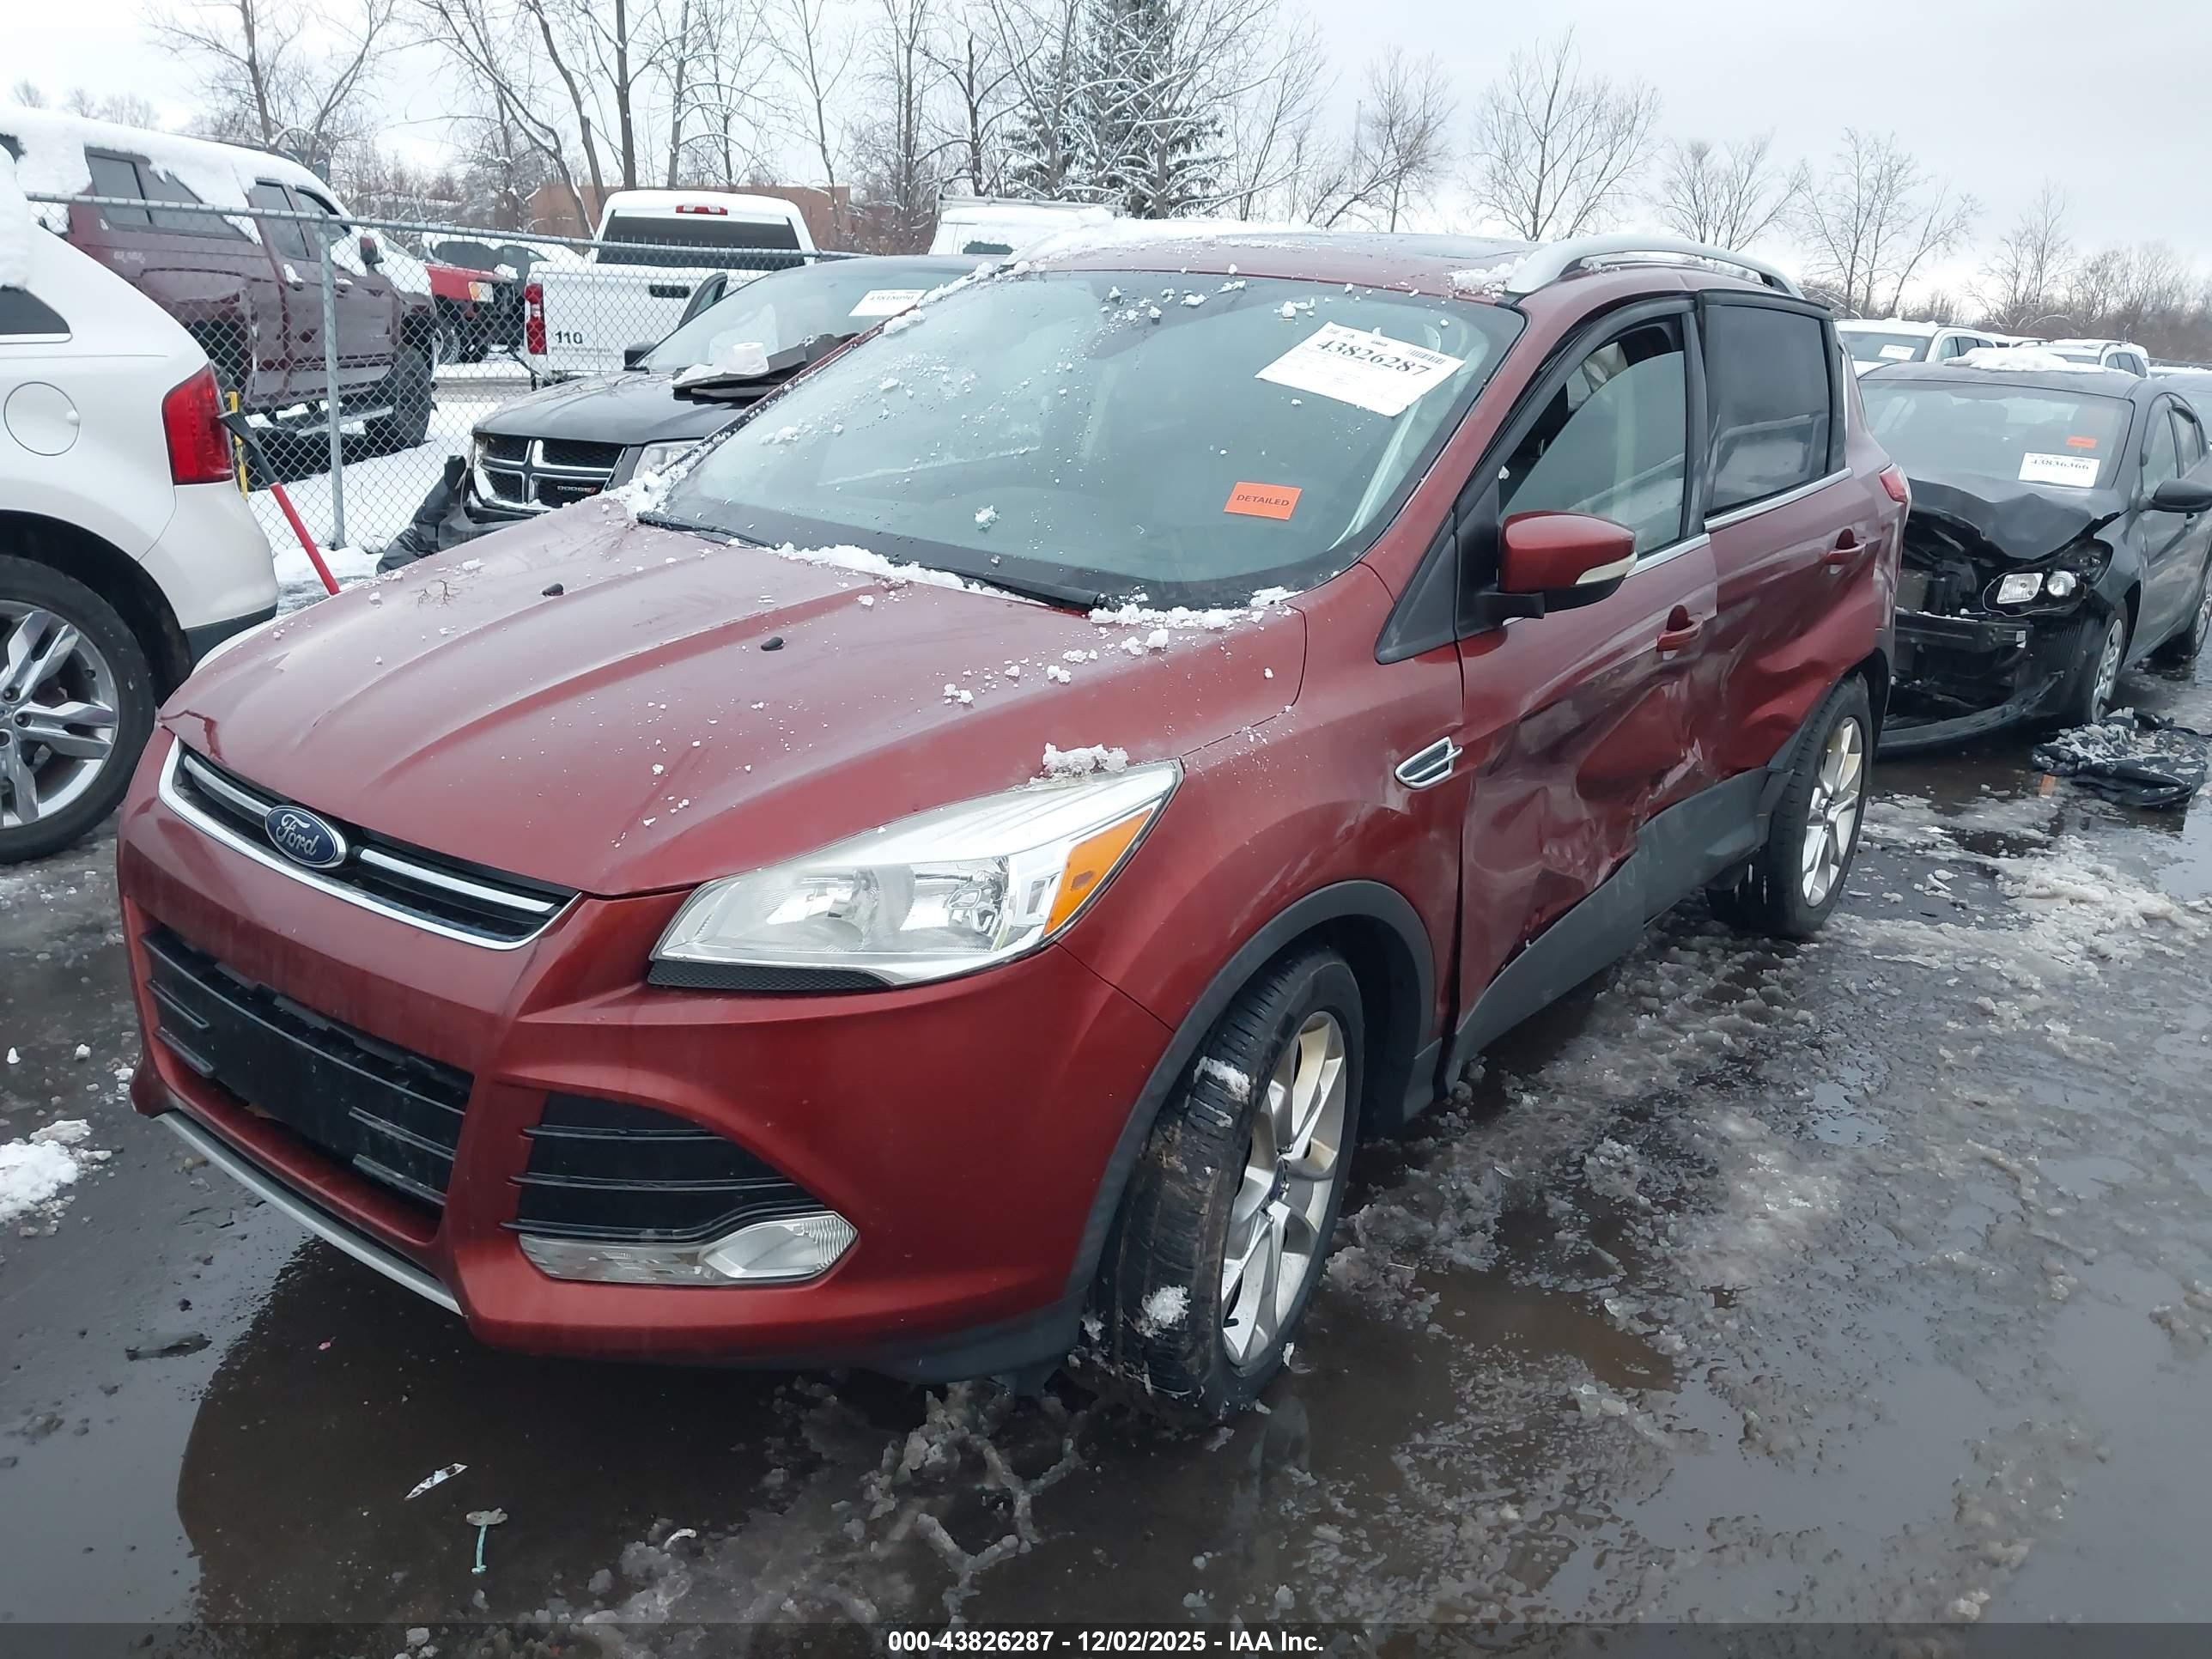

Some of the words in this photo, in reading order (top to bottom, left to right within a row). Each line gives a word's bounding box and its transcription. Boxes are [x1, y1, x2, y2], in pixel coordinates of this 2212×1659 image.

[555, 331, 583, 344] 110
[1317, 340, 1432, 376] 43826287
[1237, 494, 1290, 507] DETAILED
[276, 813, 320, 857] Ford
